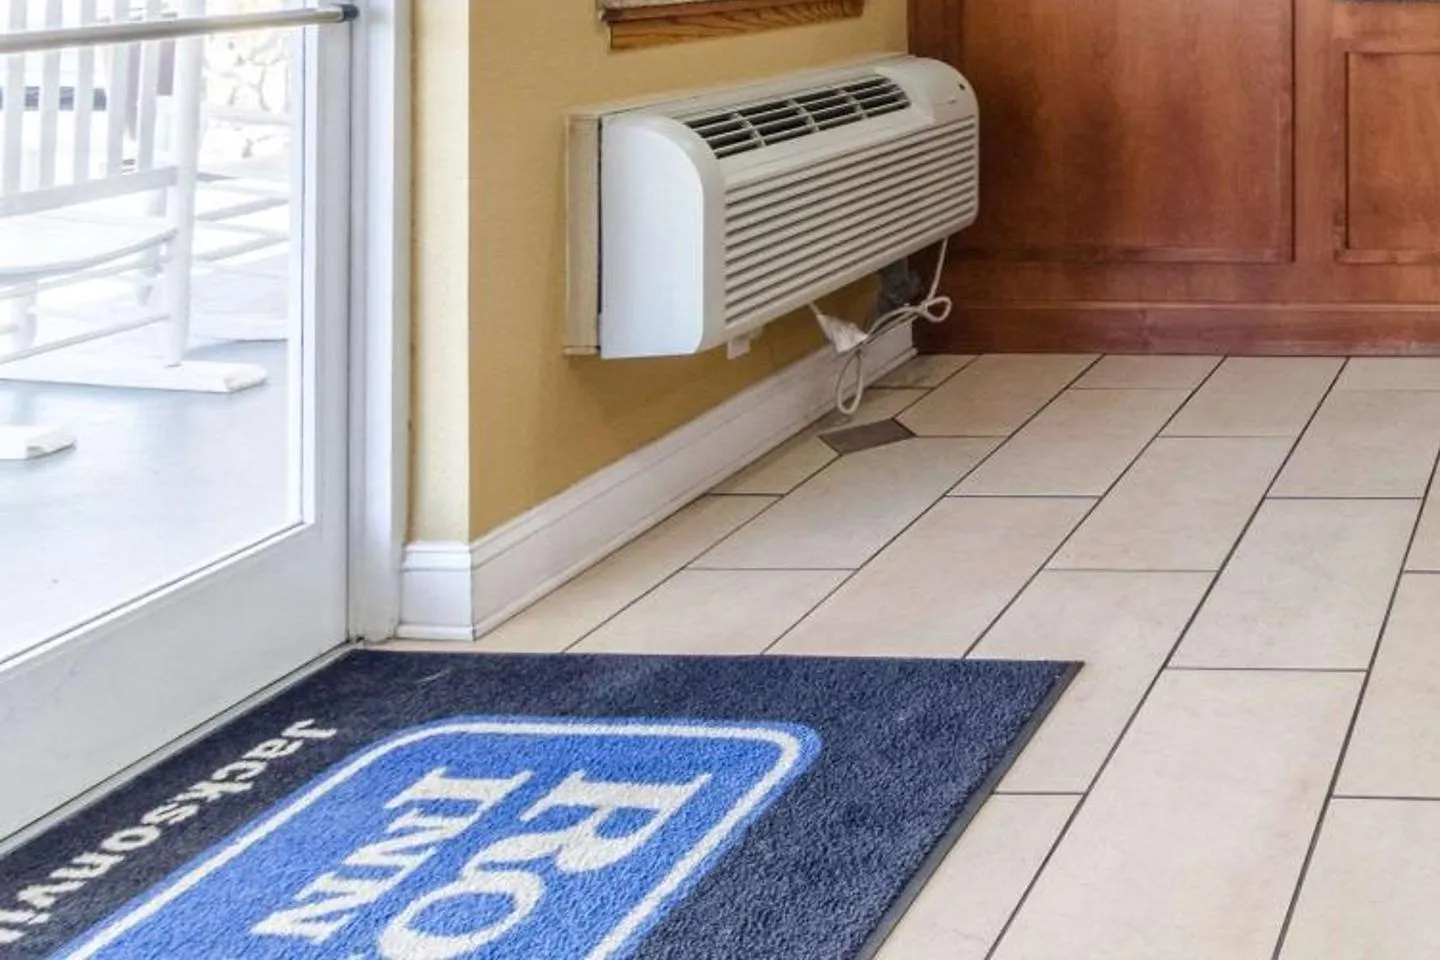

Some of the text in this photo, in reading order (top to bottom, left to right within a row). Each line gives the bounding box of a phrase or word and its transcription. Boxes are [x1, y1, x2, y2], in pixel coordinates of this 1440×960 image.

[0, 718, 338, 944] Jacksonvi
[249, 766, 535, 944] INN
[347, 769, 713, 960] RO
